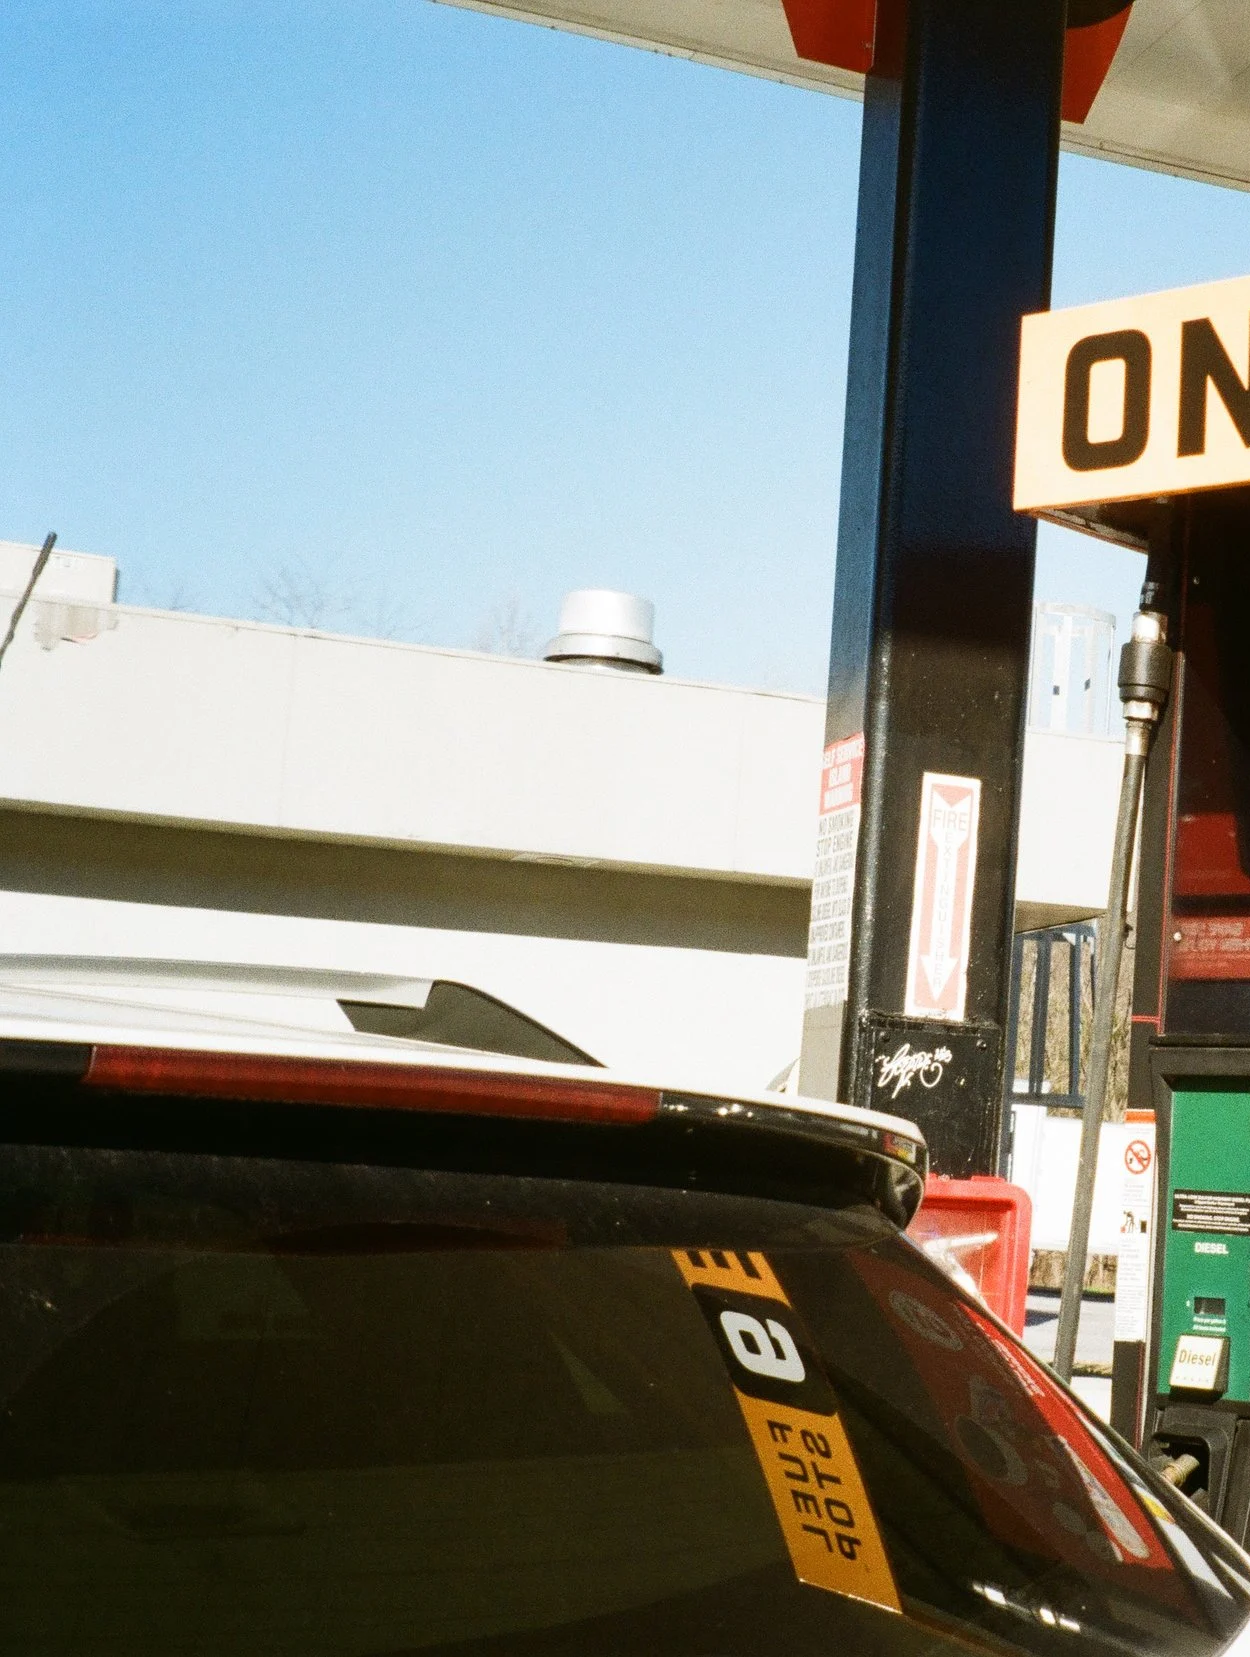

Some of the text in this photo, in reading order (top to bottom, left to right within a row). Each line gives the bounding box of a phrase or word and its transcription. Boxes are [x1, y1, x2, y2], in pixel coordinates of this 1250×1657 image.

[932, 809, 968, 831] FIRE
[1194, 1241, 1230, 1255] DIESEL
[1178, 1349, 1217, 1367] Diesel
